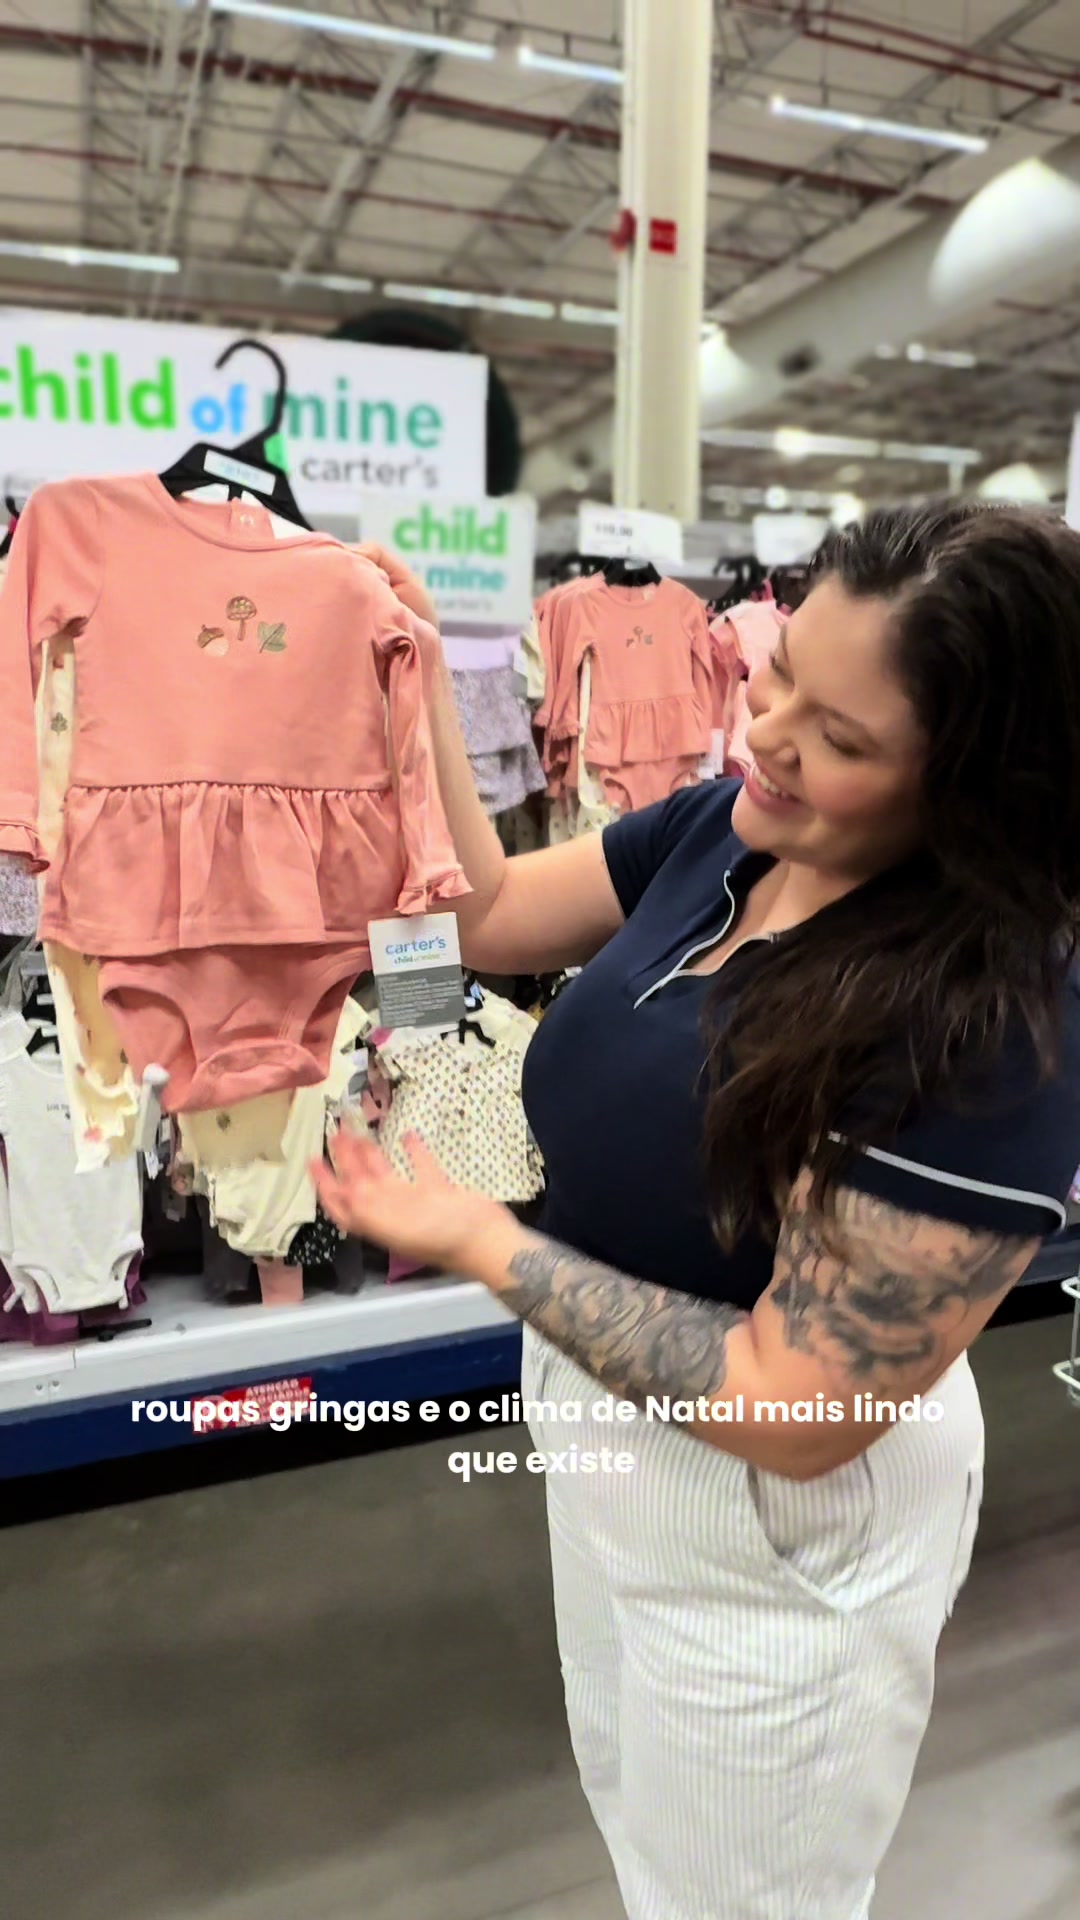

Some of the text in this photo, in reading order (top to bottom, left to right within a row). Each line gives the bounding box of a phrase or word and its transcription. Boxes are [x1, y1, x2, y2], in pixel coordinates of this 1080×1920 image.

[191, 384, 247, 433] of
[263, 377, 443, 449] mine
[300, 456, 440, 488] carter's
[393, 502, 508, 557] child
[426, 559, 507, 592] mine
[385, 935, 447, 955] carter's
